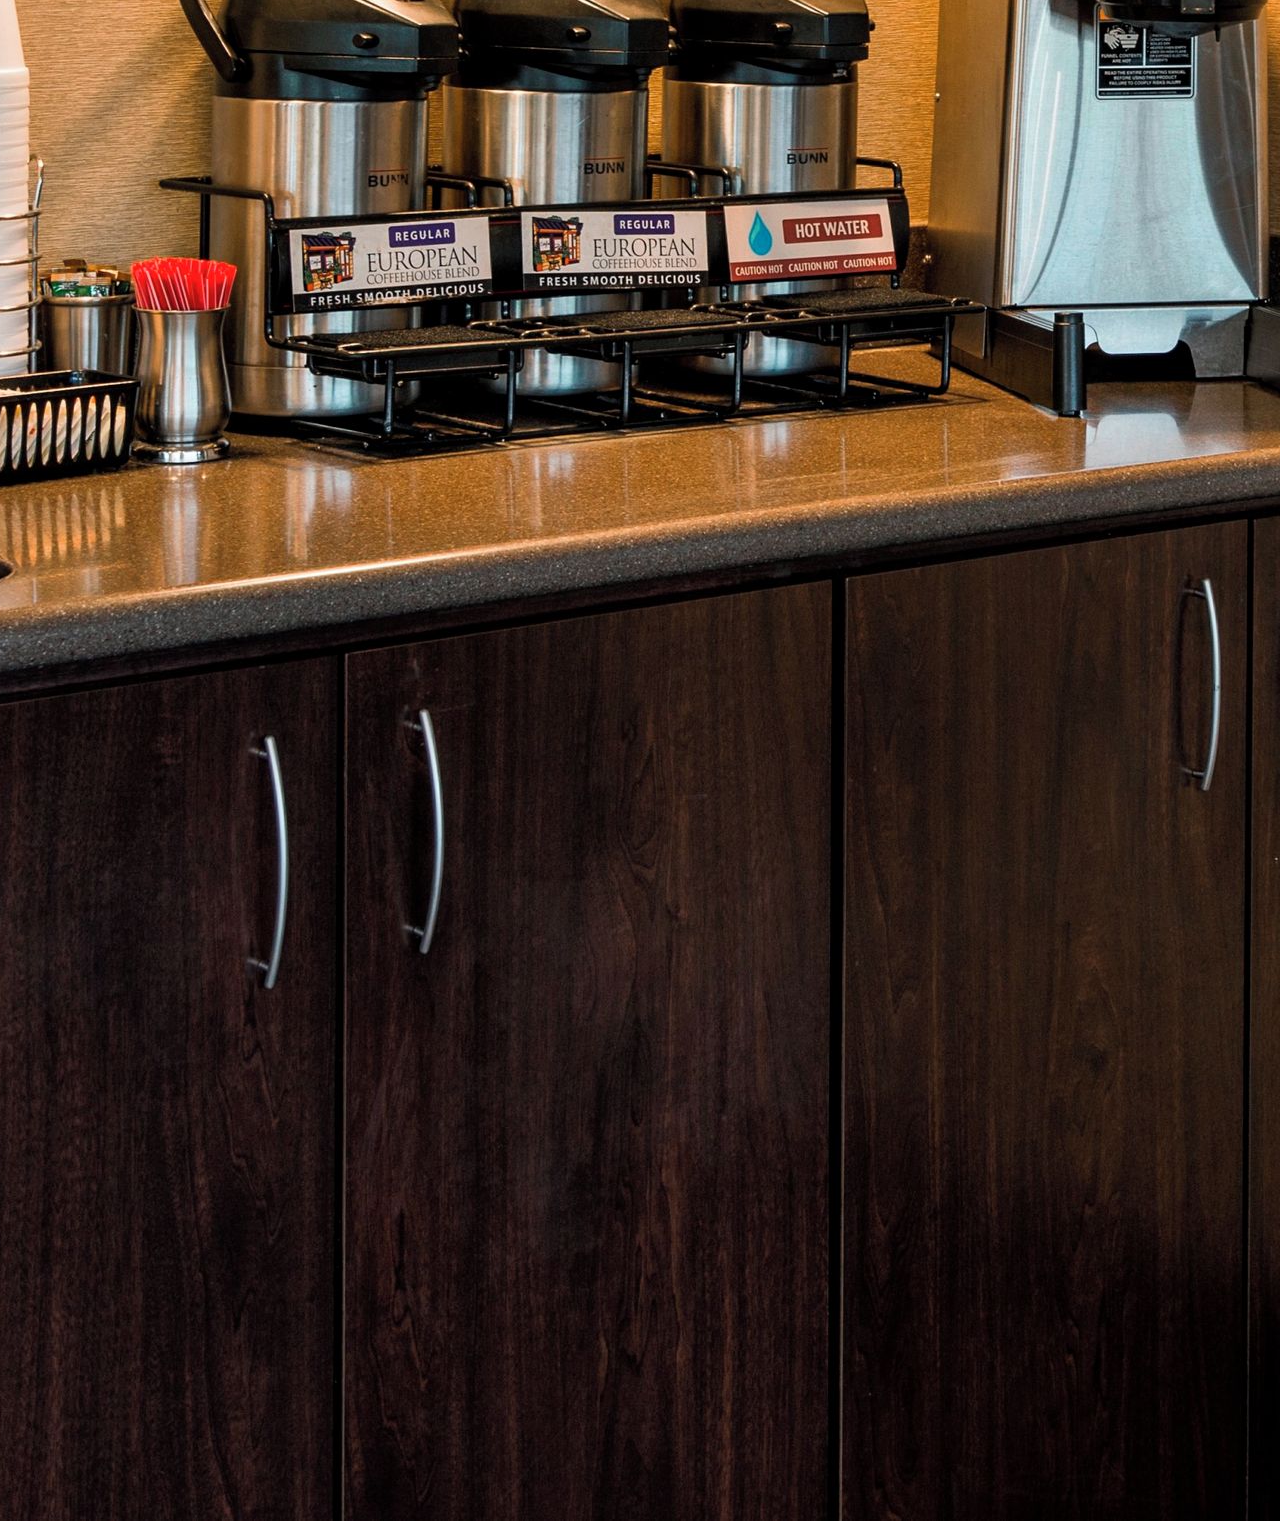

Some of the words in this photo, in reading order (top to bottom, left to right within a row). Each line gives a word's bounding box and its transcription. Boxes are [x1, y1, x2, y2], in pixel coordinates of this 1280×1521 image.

[787, 151, 829, 165] BUNN
[584, 161, 625, 175] BUNN
[367, 173, 409, 187] BUNN
[619, 219, 671, 229] REGULAR
[795, 222, 821, 239] HOT
[823, 219, 870, 237] WATER
[395, 228, 451, 242] REGULAR
[593, 237, 696, 258] EUROPEAN
[366, 245, 478, 273] EUROPEAN
[592, 257, 663, 270] COFFEEHOUSE
[665, 257, 698, 269] BLEND
[735, 265, 768, 277] CAUTION
[768, 263, 784, 274] HOT
[788, 262, 822, 273] CAUTION
[823, 260, 838, 270] HOT
[843, 258, 877, 269] CAUTION
[877, 256, 893, 267] HOT
[366, 268, 443, 285] COFFEEHOUSE
[445, 266, 480, 279] BLEND
[539, 276, 578, 287] FRESH
[582, 275, 634, 286] SMOOTH
[638, 274, 702, 285] DELICIOUS
[310, 294, 351, 306] FRESH
[356, 289, 411, 303] SMOOTH
[416, 283, 485, 297] DELICIOUS
